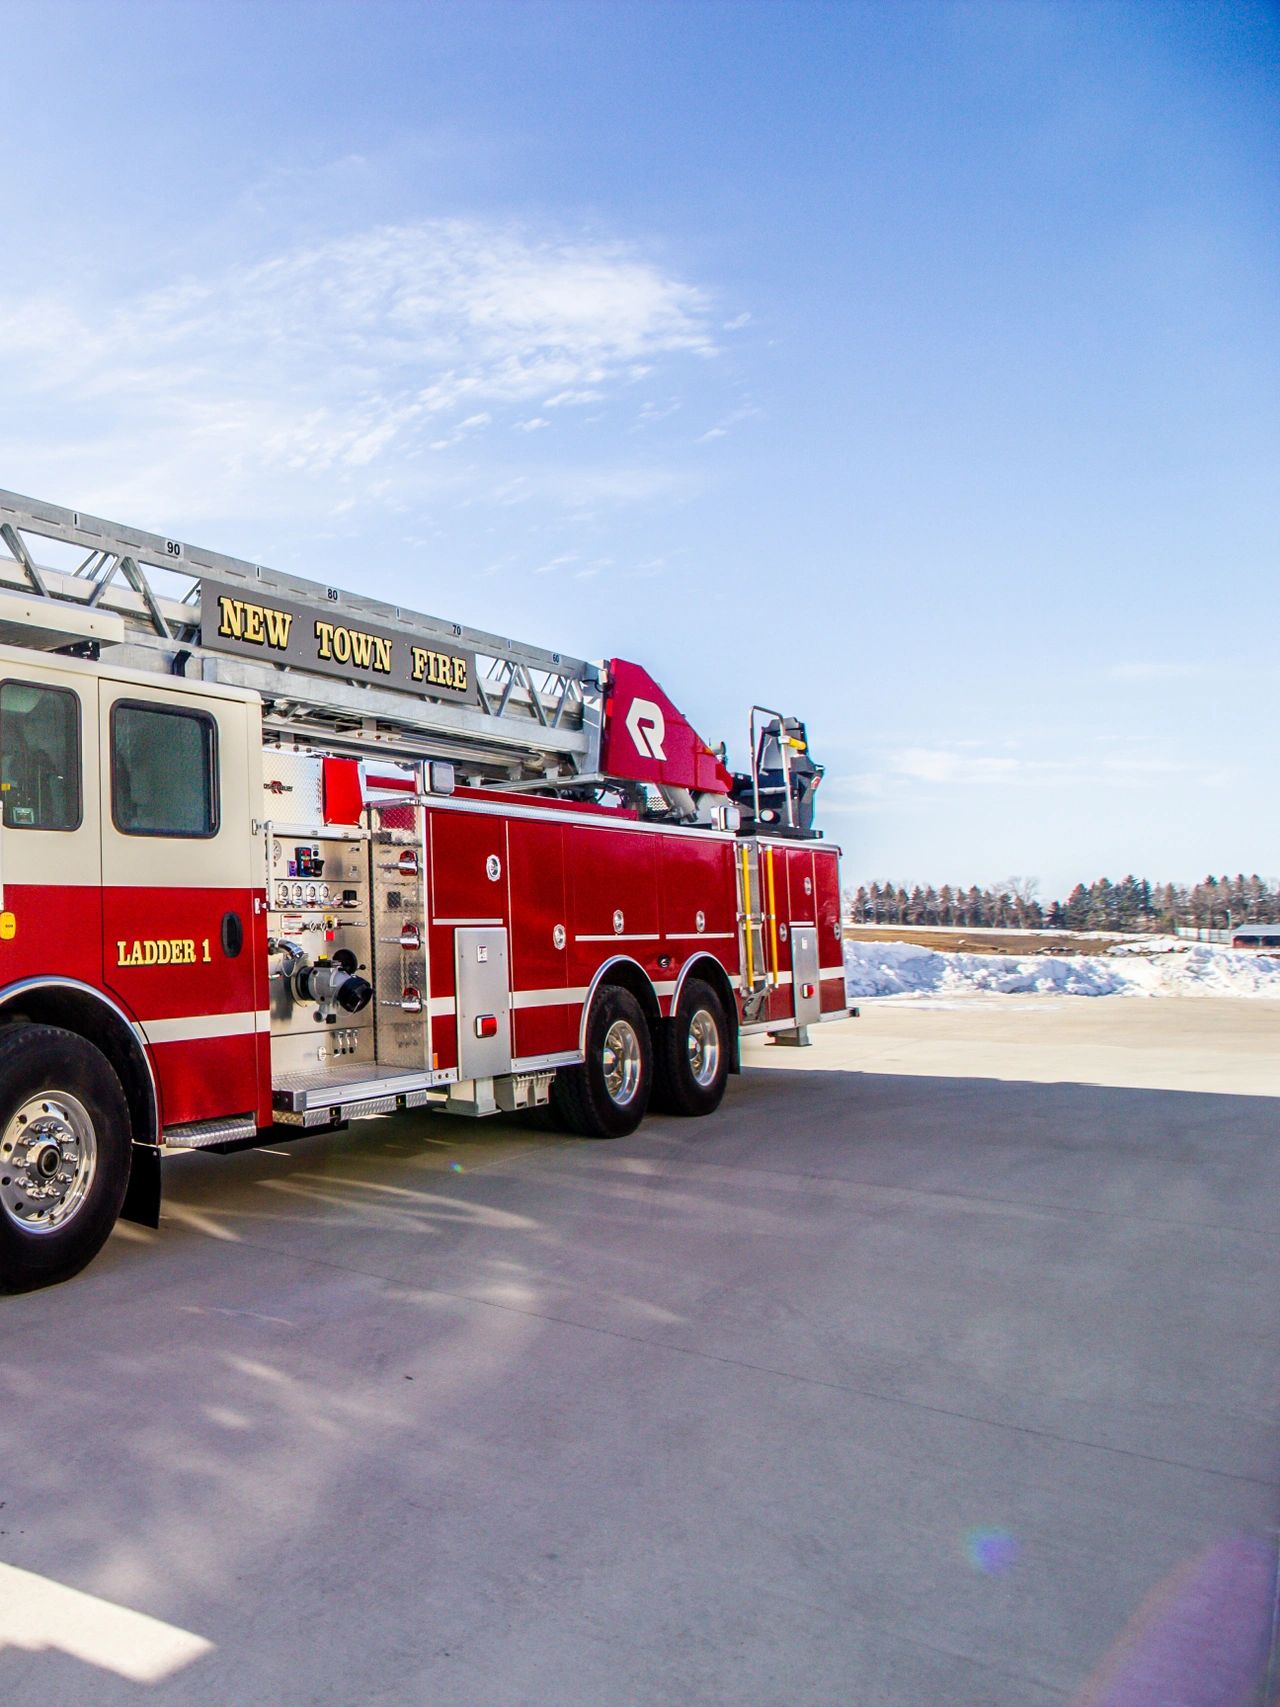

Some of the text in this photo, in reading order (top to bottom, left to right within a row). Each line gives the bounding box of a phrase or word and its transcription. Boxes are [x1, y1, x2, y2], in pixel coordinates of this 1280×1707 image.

[166, 541, 181, 556] 90
[327, 588, 339, 601] 80
[452, 624, 462, 636] 70
[218, 596, 467, 691] NEW TOWN FIRE
[552, 653, 560, 664] 60
[116, 938, 212, 966] LADDER 1
